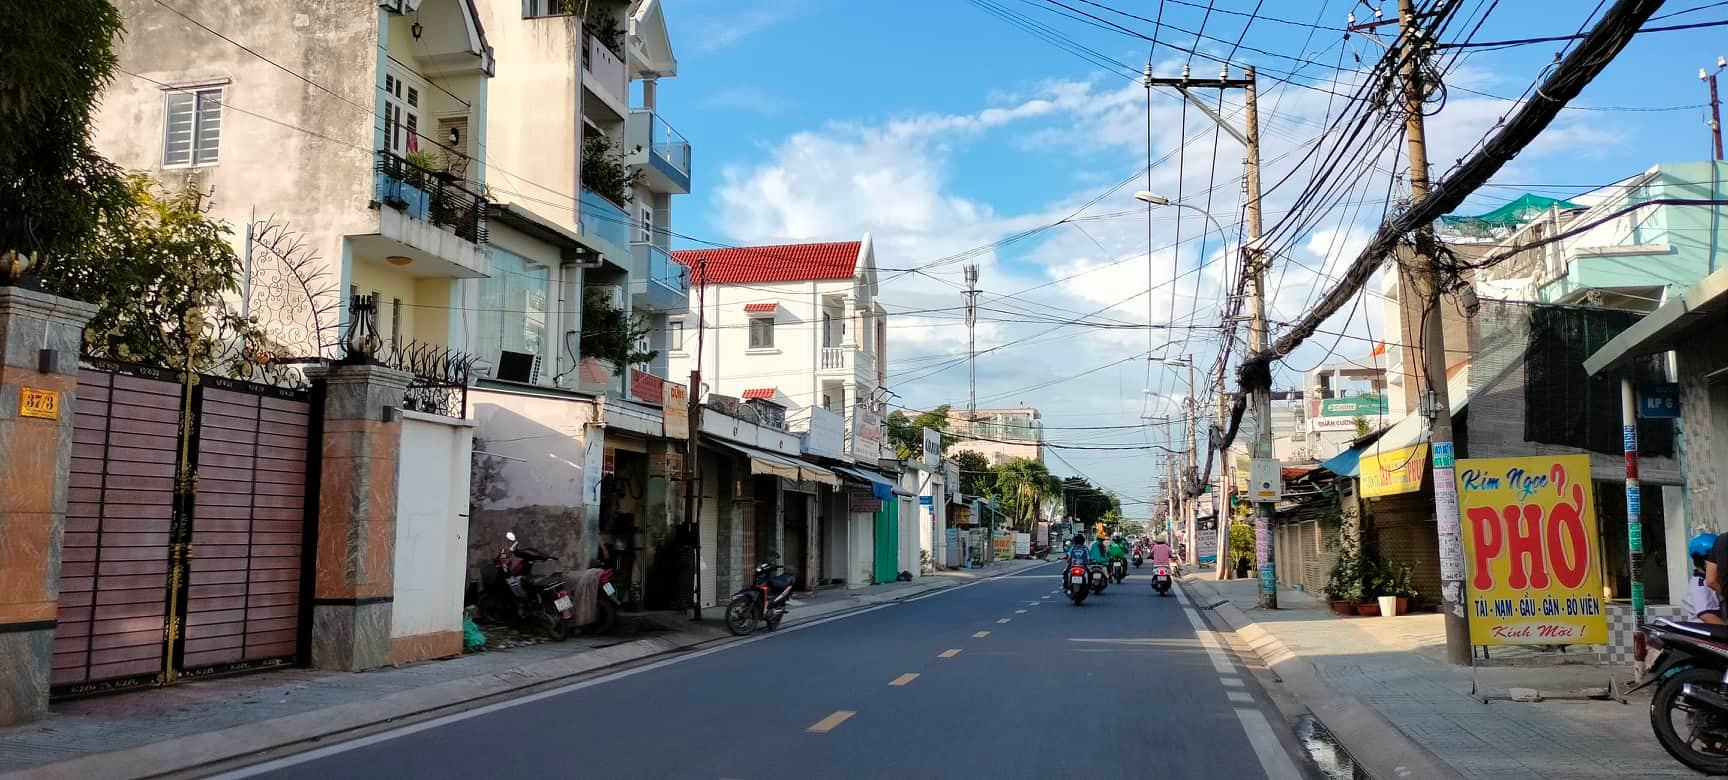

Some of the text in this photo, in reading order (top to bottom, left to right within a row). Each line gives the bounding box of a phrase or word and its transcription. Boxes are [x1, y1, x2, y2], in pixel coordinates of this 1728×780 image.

[27, 393, 54, 410] 37/3
[1461, 469, 1500, 491] Kim
[1507, 467, 1548, 501] Ngọc
[1466, 463, 1590, 591] PHỞ
[1474, 595, 1488, 617] TÁI
[1494, 599, 1513, 620] NẠM
[1519, 591, 1536, 617] GẦU
[1579, 592, 1600, 616] VIÊN
[1492, 625, 1531, 638] Kính
